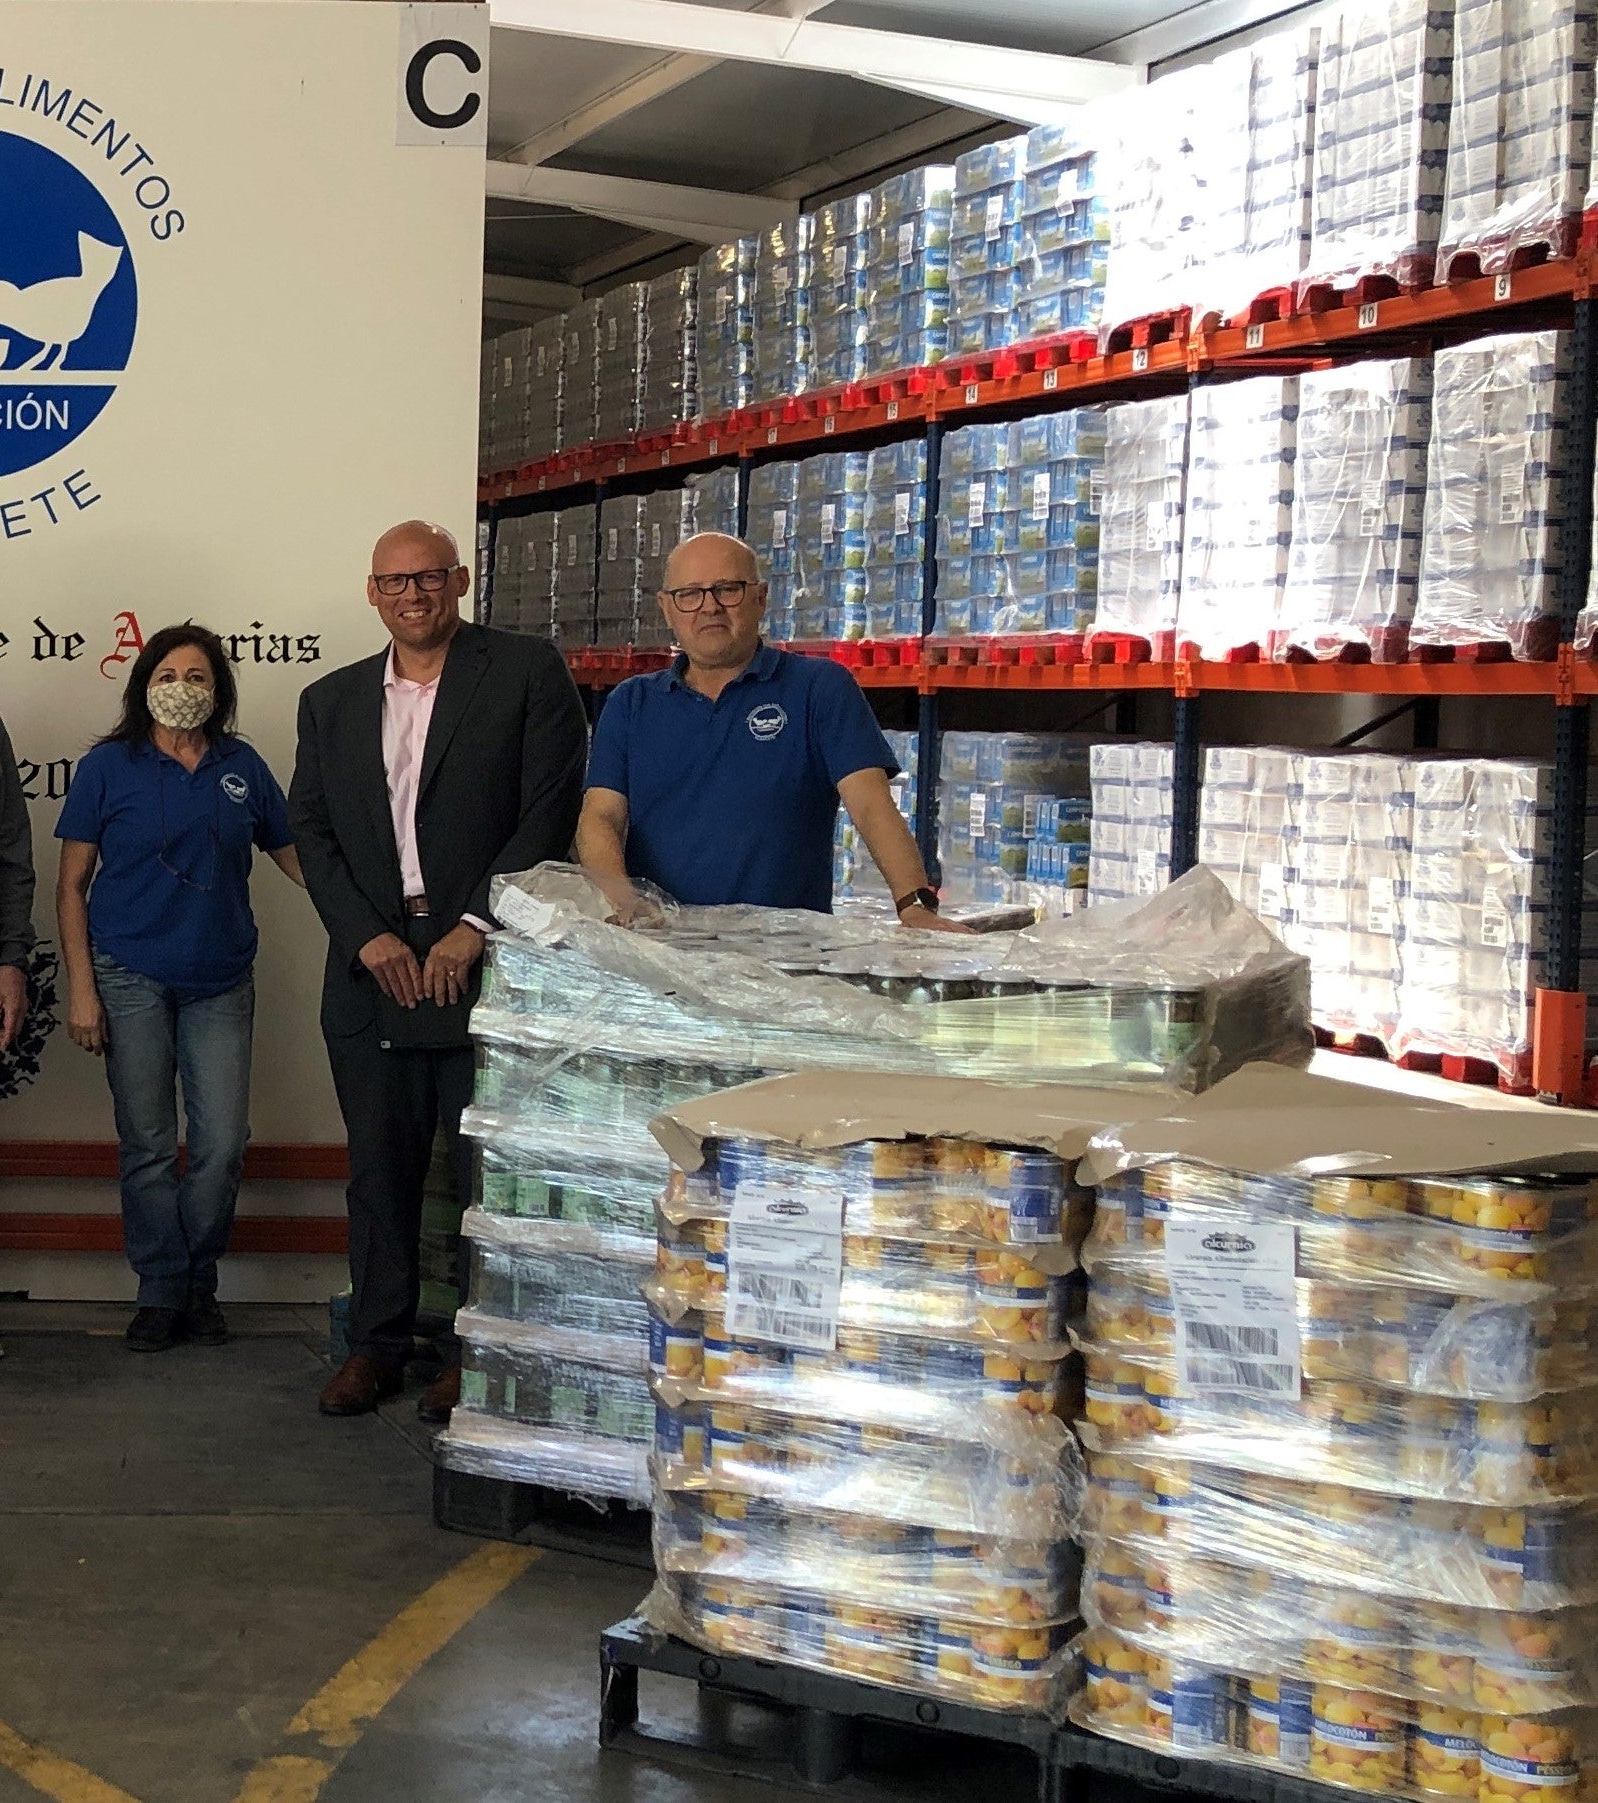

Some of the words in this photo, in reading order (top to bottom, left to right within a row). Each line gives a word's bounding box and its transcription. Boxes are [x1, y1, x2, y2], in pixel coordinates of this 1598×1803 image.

[404, 38, 482, 130] C
[1498, 278, 1507, 297] 9
[1361, 306, 1375, 325] 10
[1249, 328, 1260, 345] 11
[1136, 349, 1146, 366] 12
[1045, 371, 1055, 388] 13
[31, 616, 87, 662] de
[99, 610, 322, 680] Arias
